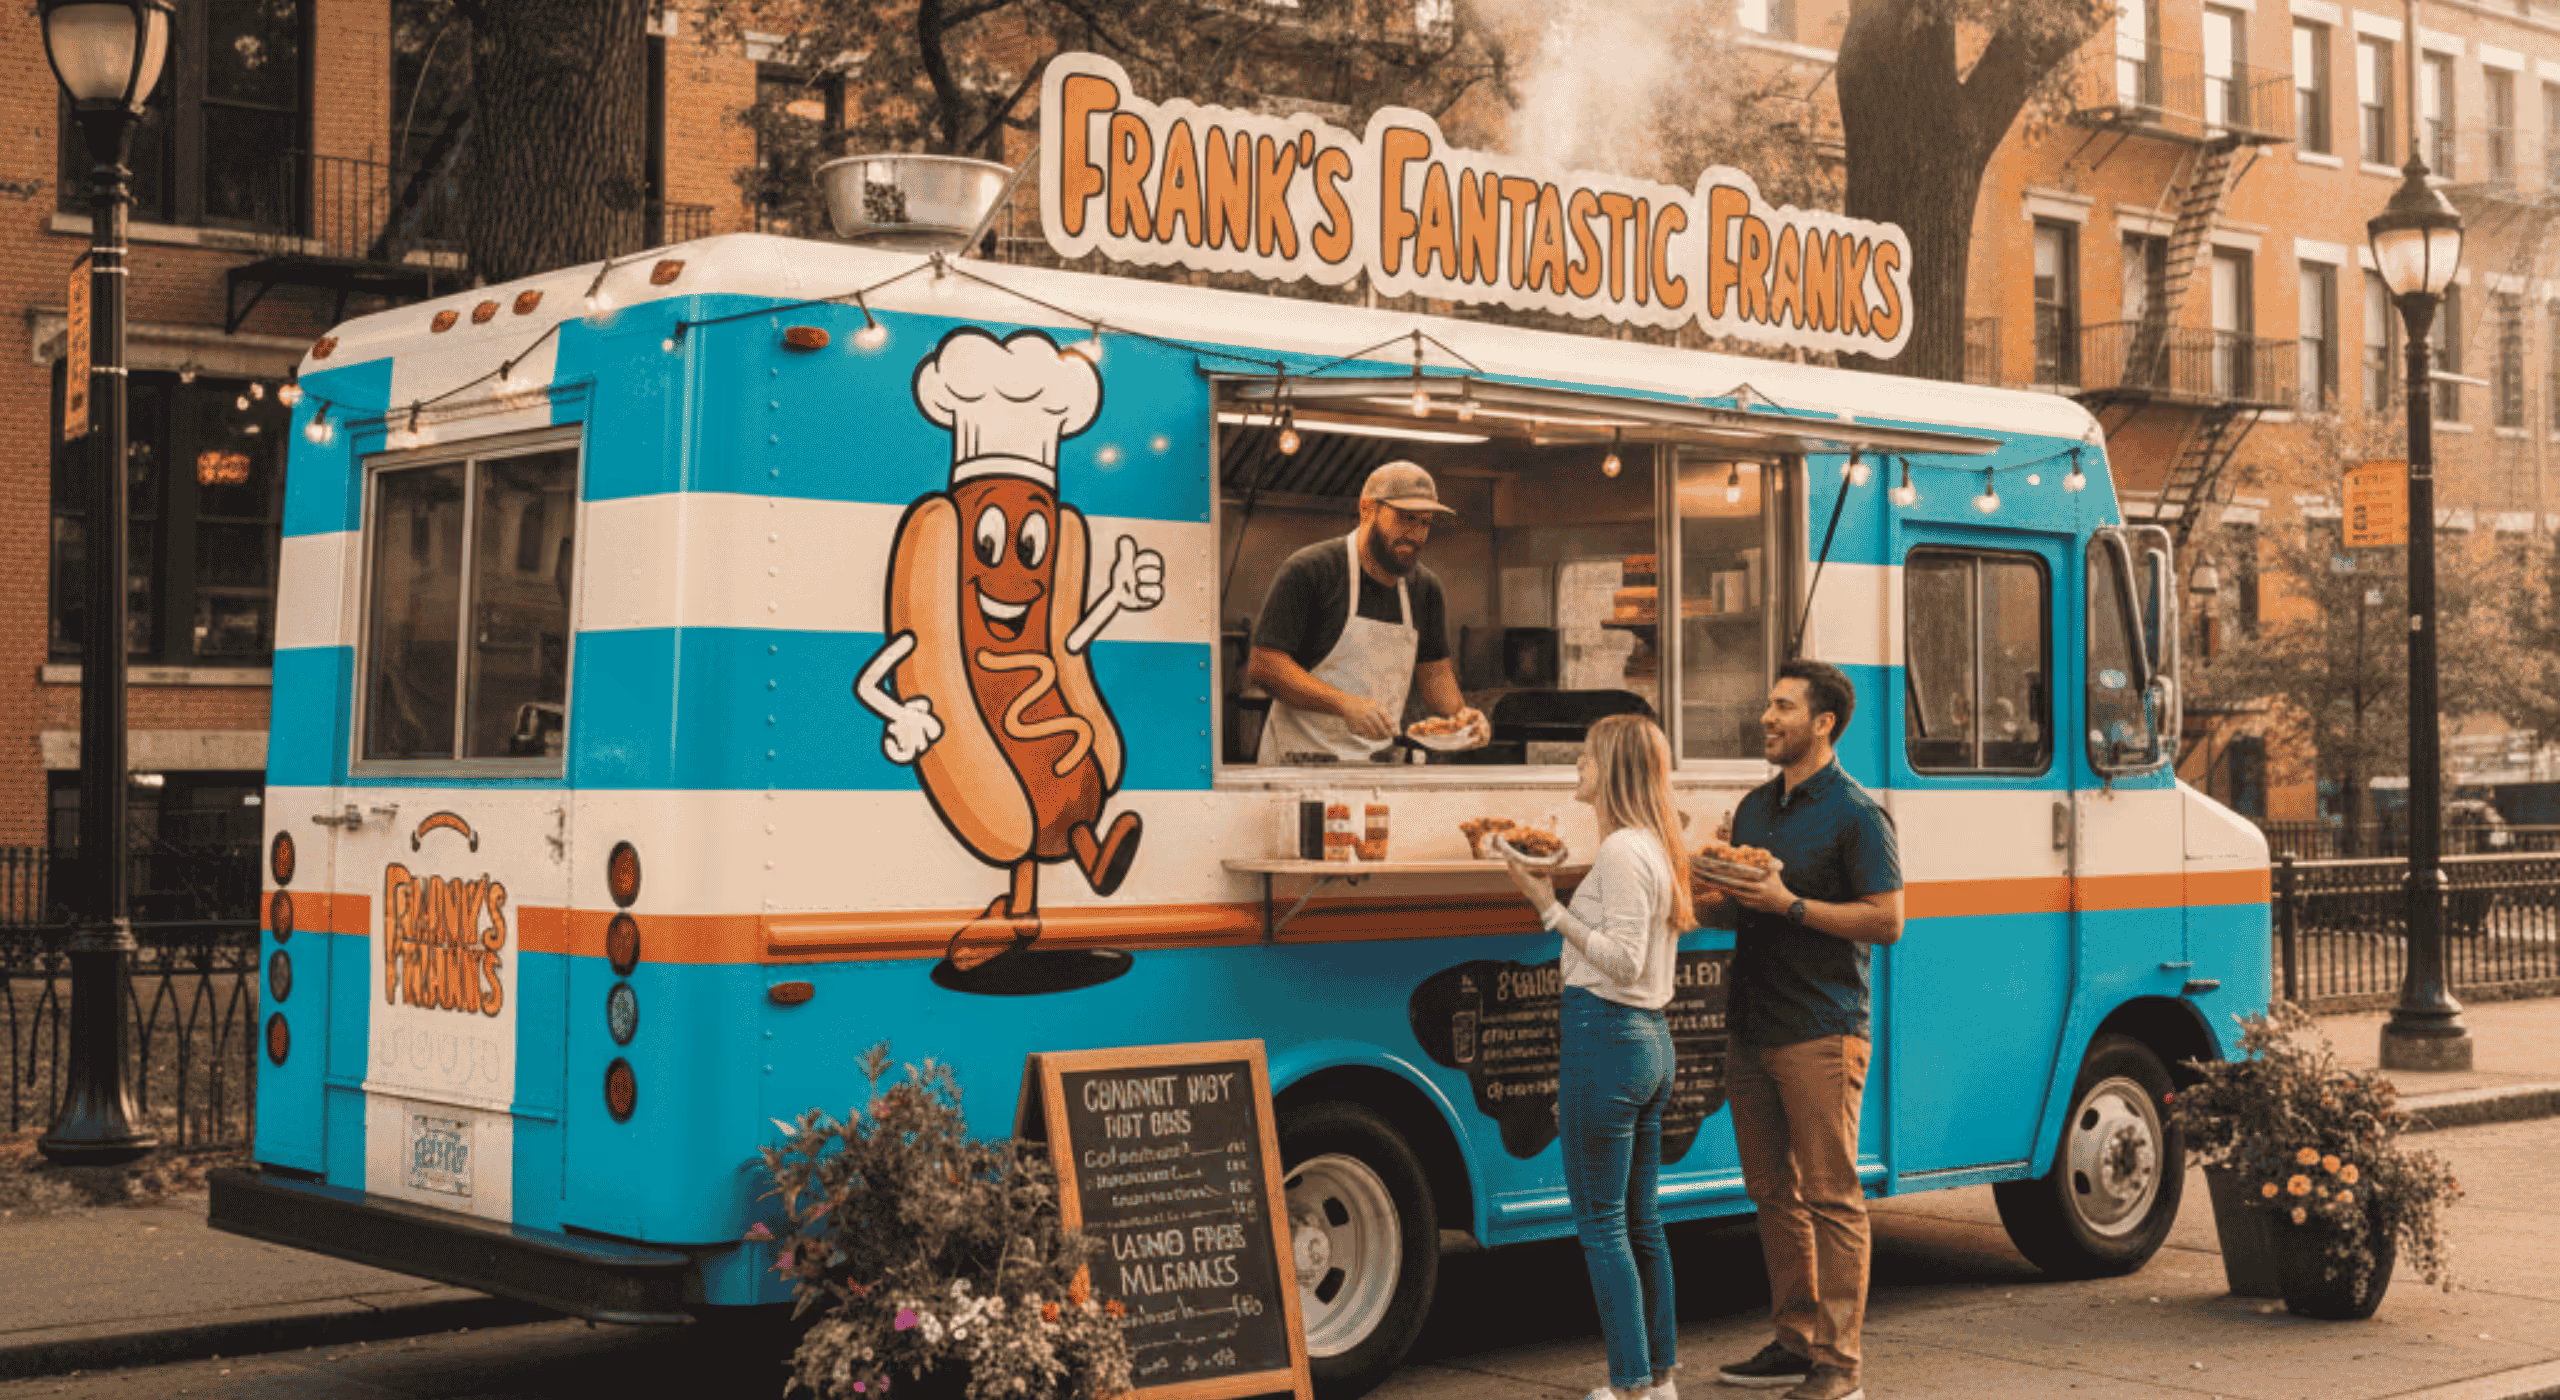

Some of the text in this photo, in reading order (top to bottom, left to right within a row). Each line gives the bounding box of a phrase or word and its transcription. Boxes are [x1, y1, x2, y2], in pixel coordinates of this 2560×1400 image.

[1061, 72, 1903, 341] FRANK'S FANTASTIC FRANKS
